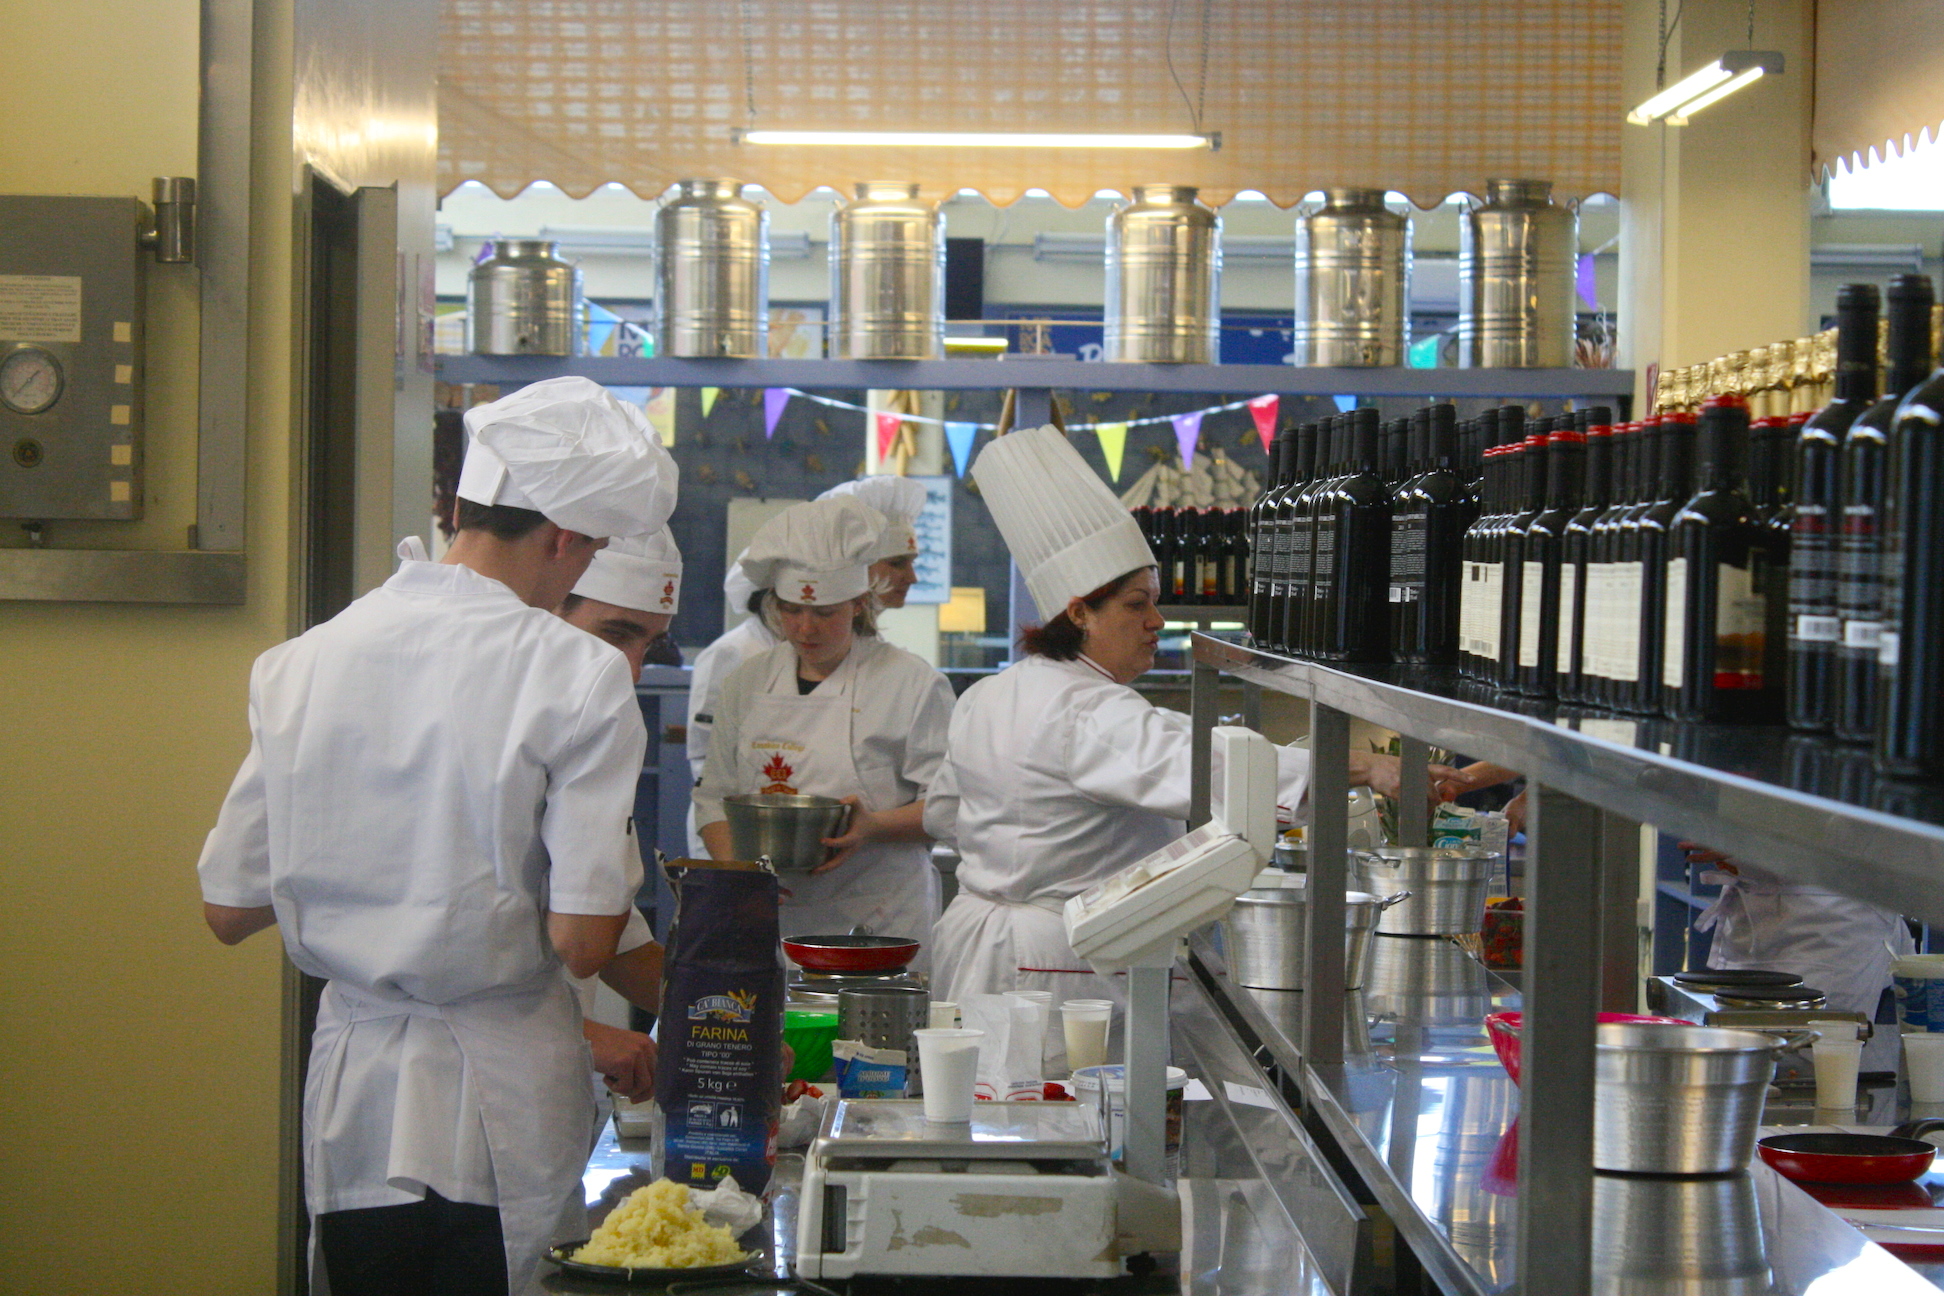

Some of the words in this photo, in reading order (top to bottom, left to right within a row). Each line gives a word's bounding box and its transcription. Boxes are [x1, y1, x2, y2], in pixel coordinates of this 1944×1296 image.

[711, 999, 742, 1014] BIANCA
[691, 1026, 749, 1042] FARINA
[695, 1041, 722, 1050] GRANO
[723, 1043, 753, 1051] TENERO
[701, 1050, 718, 1058] TIPO
[697, 1077, 705, 1089] 5
[707, 1078, 722, 1092] kg
